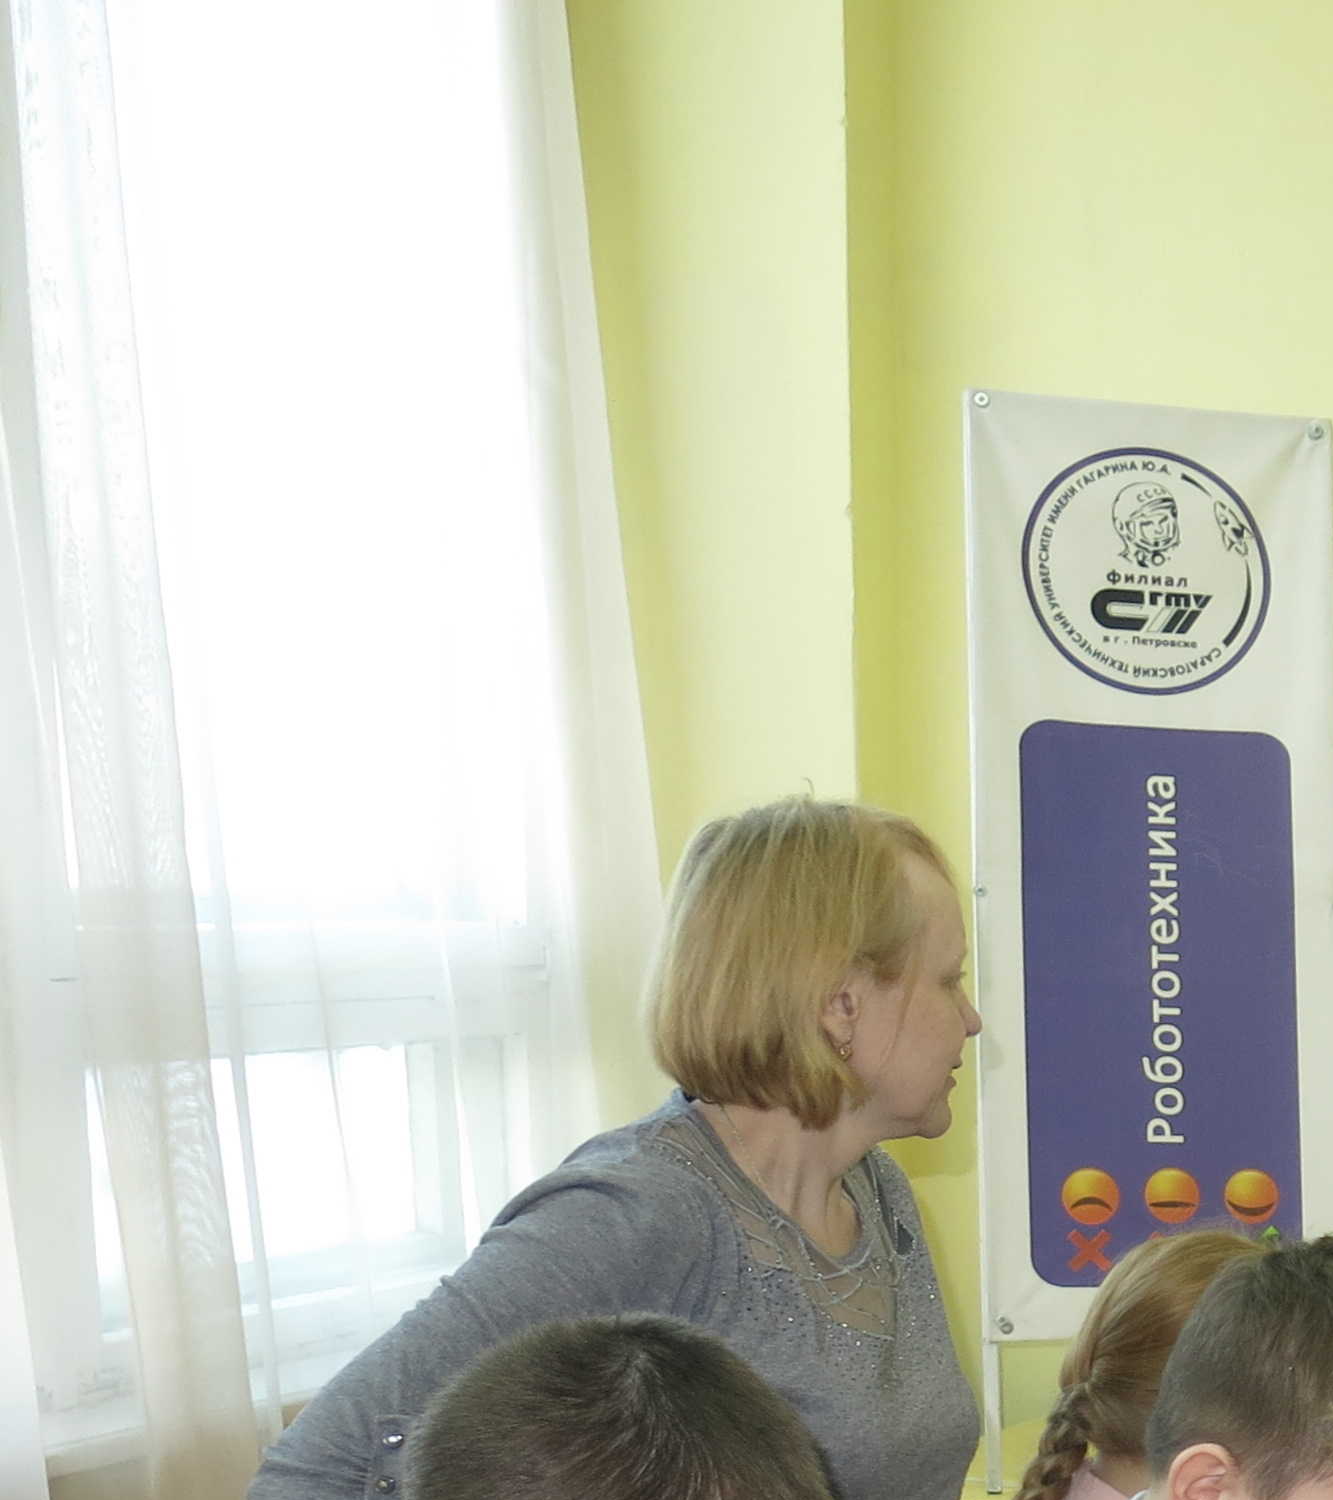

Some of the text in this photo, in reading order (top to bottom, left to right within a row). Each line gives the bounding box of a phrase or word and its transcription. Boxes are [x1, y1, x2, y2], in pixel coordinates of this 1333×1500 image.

[1047, 485, 1078, 525] ИМЕНИ
[1076, 461, 1138, 490] ГАГАРИНА
[1038, 525, 1059, 611] УНИВЕРСИТЕТ
[1142, 773, 1185, 1144] Робототехника
